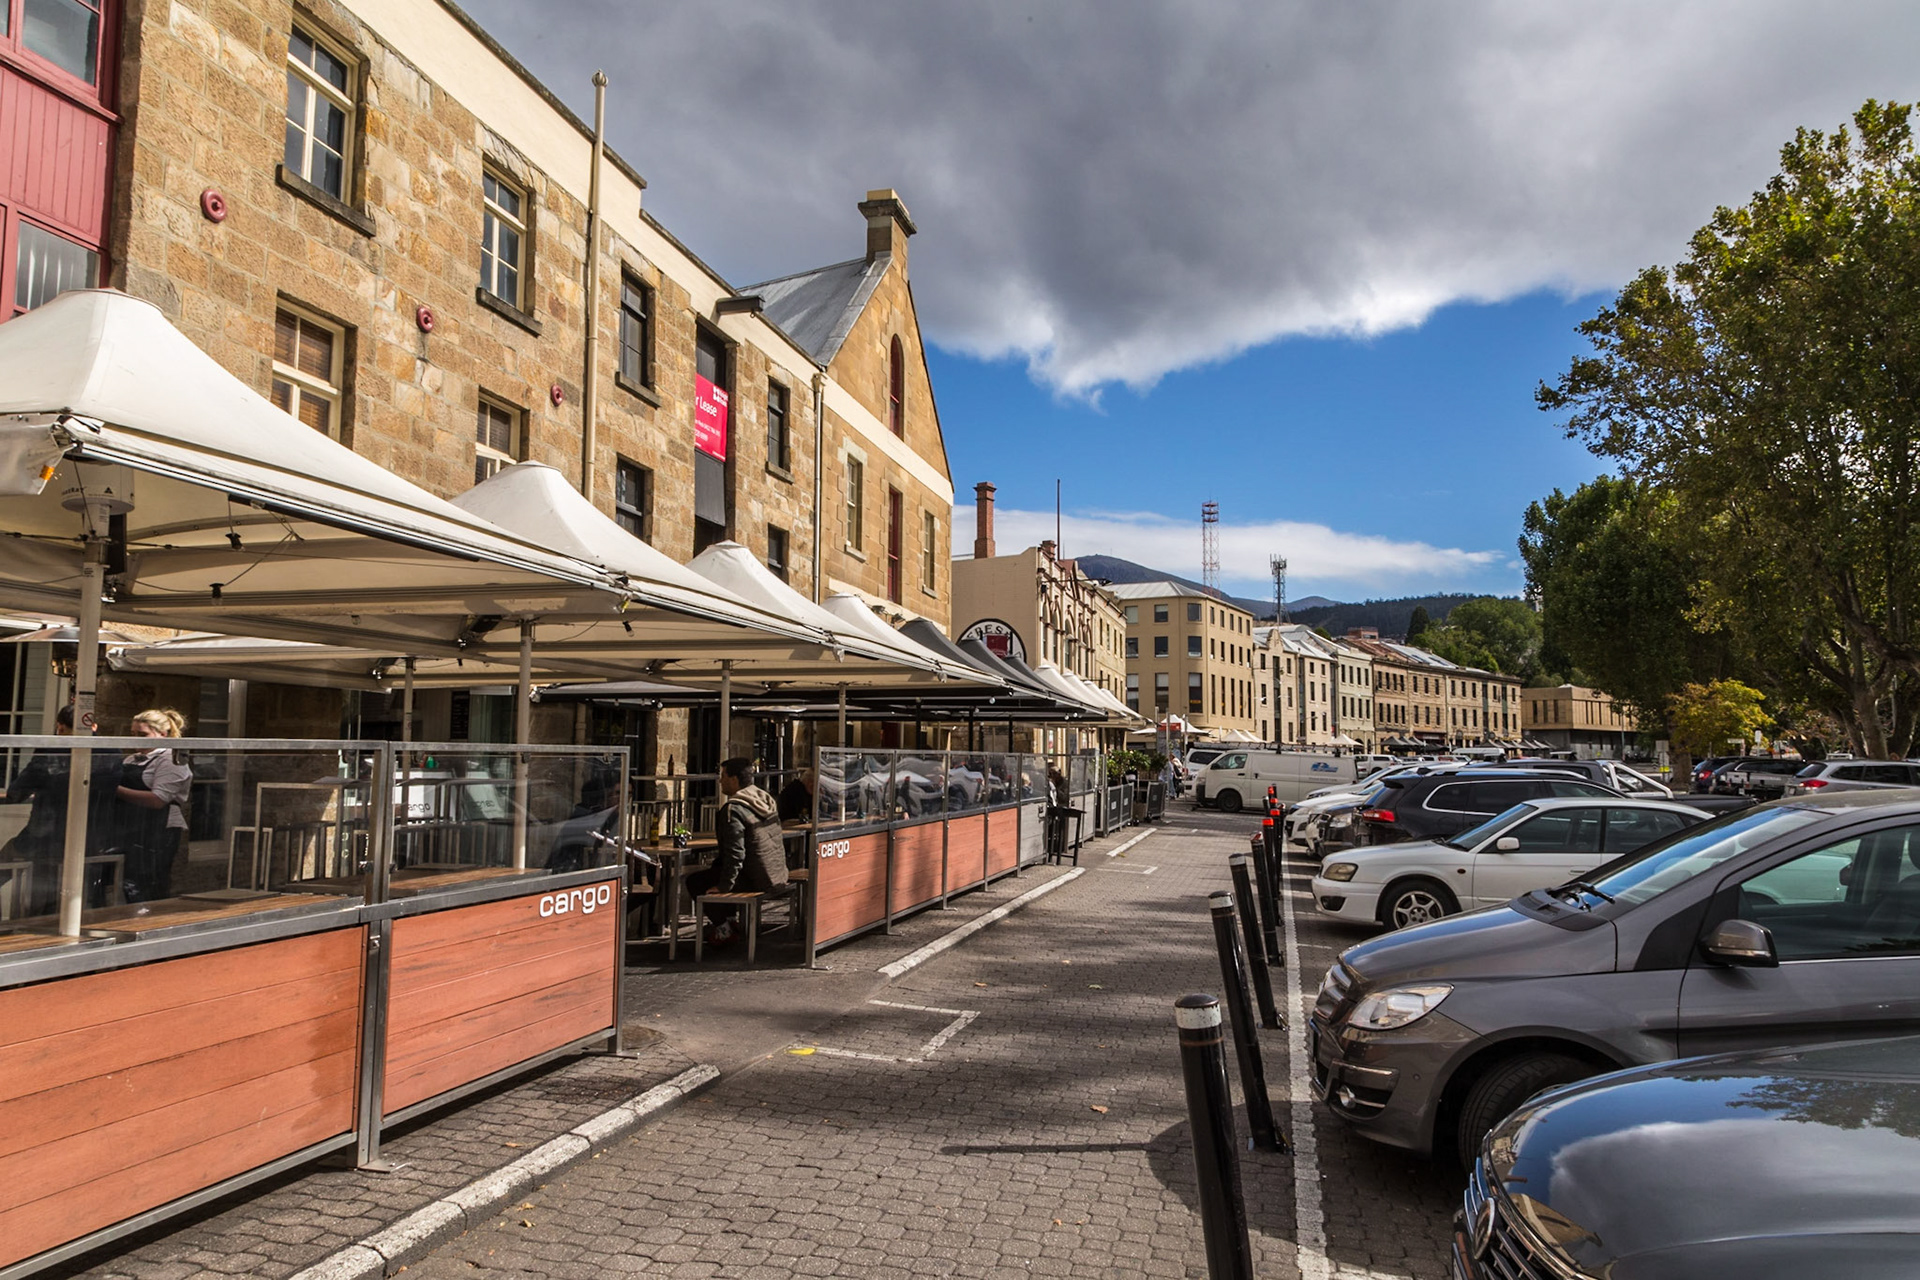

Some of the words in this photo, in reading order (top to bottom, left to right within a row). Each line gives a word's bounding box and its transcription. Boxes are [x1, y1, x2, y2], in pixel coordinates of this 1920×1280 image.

[699, 396, 718, 417] Lease
[966, 624, 1011, 640] FRES
[408, 803, 430, 813] argo
[821, 840, 850, 859] cargo
[540, 885, 610, 917] cargo
